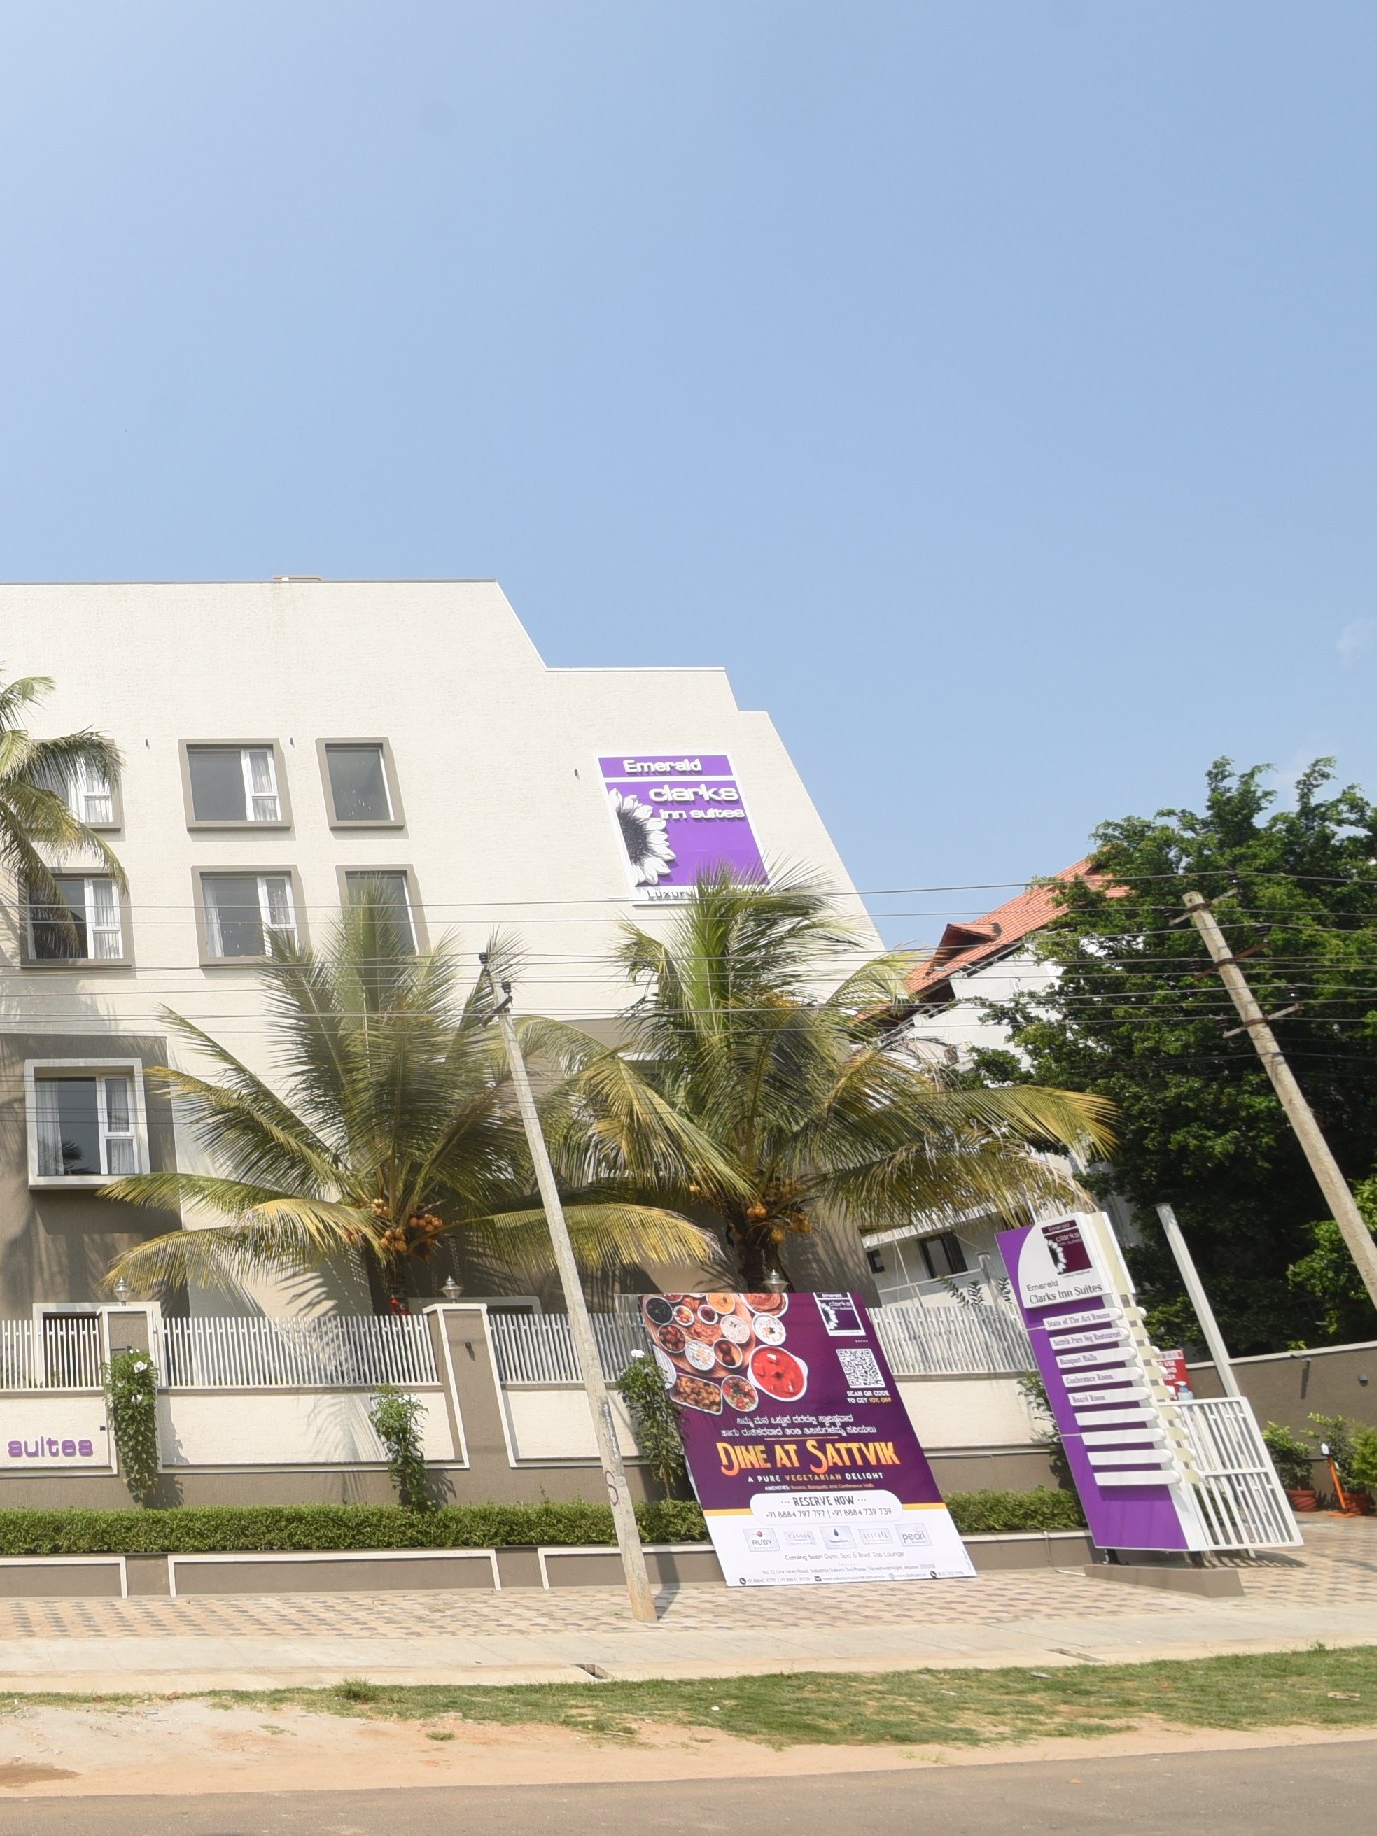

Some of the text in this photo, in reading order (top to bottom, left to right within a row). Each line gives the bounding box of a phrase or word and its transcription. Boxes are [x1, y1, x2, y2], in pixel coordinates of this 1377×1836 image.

[623, 758, 702, 773] Emerald
[649, 783, 739, 802] clarks
[690, 808, 745, 819] suites
[1026, 1279, 1059, 1291] Emerald
[1030, 1284, 1103, 1304] Clarks Inn Suites
[8, 1435, 93, 1457] suites
[716, 1440, 901, 1476] DINE AT SATTVIK
[784, 1473, 842, 1481] VEGETARIAN
[845, 1472, 884, 1480] DELIGHT
[792, 1495, 854, 1506] RESERVE NOW
[902, 1530, 925, 1543] pearl
